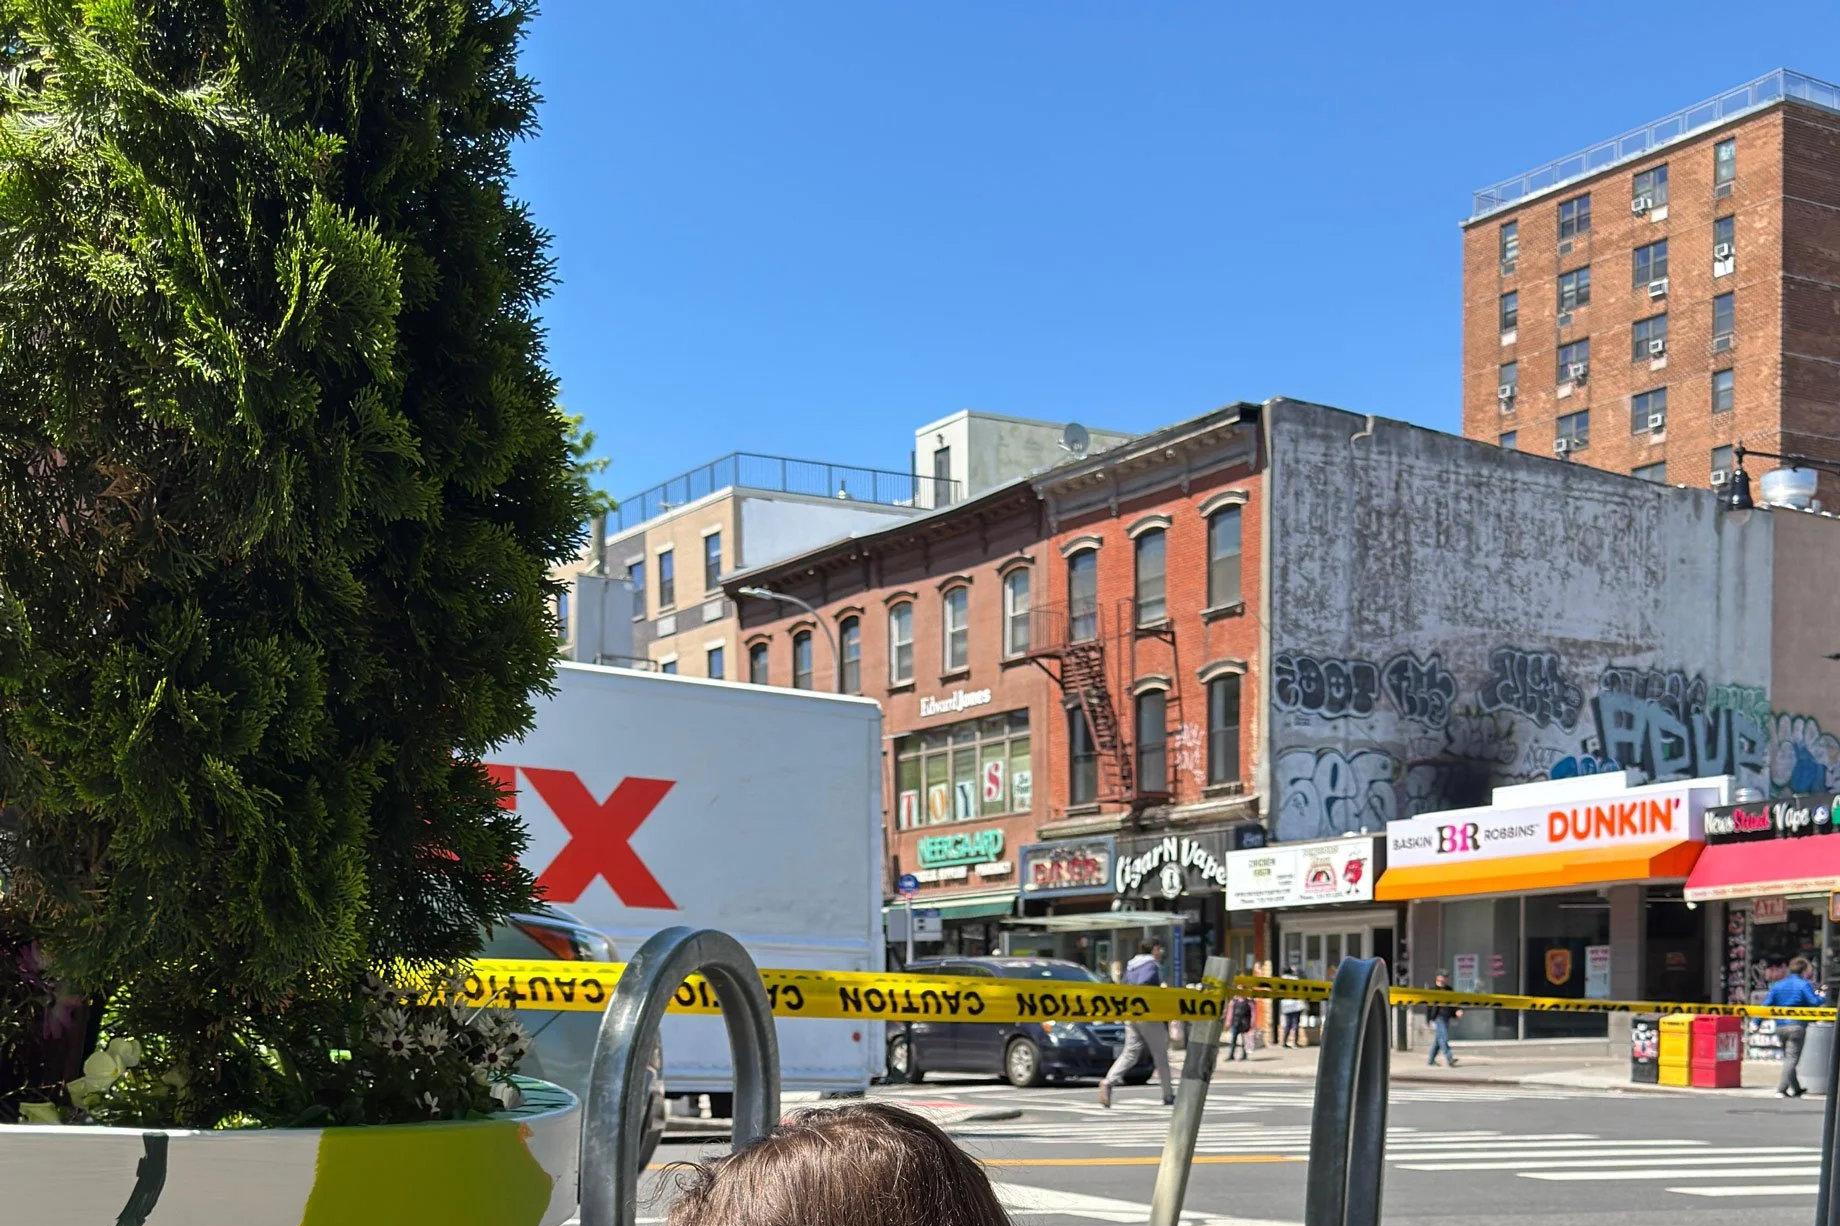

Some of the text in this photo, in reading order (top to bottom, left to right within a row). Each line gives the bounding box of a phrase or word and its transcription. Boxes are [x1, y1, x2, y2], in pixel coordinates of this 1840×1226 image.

[1547, 798, 1680, 844] DUNKIN'
[839, 987, 986, 1015] CAUTION
[1017, 993, 1151, 1017] CAUTION
